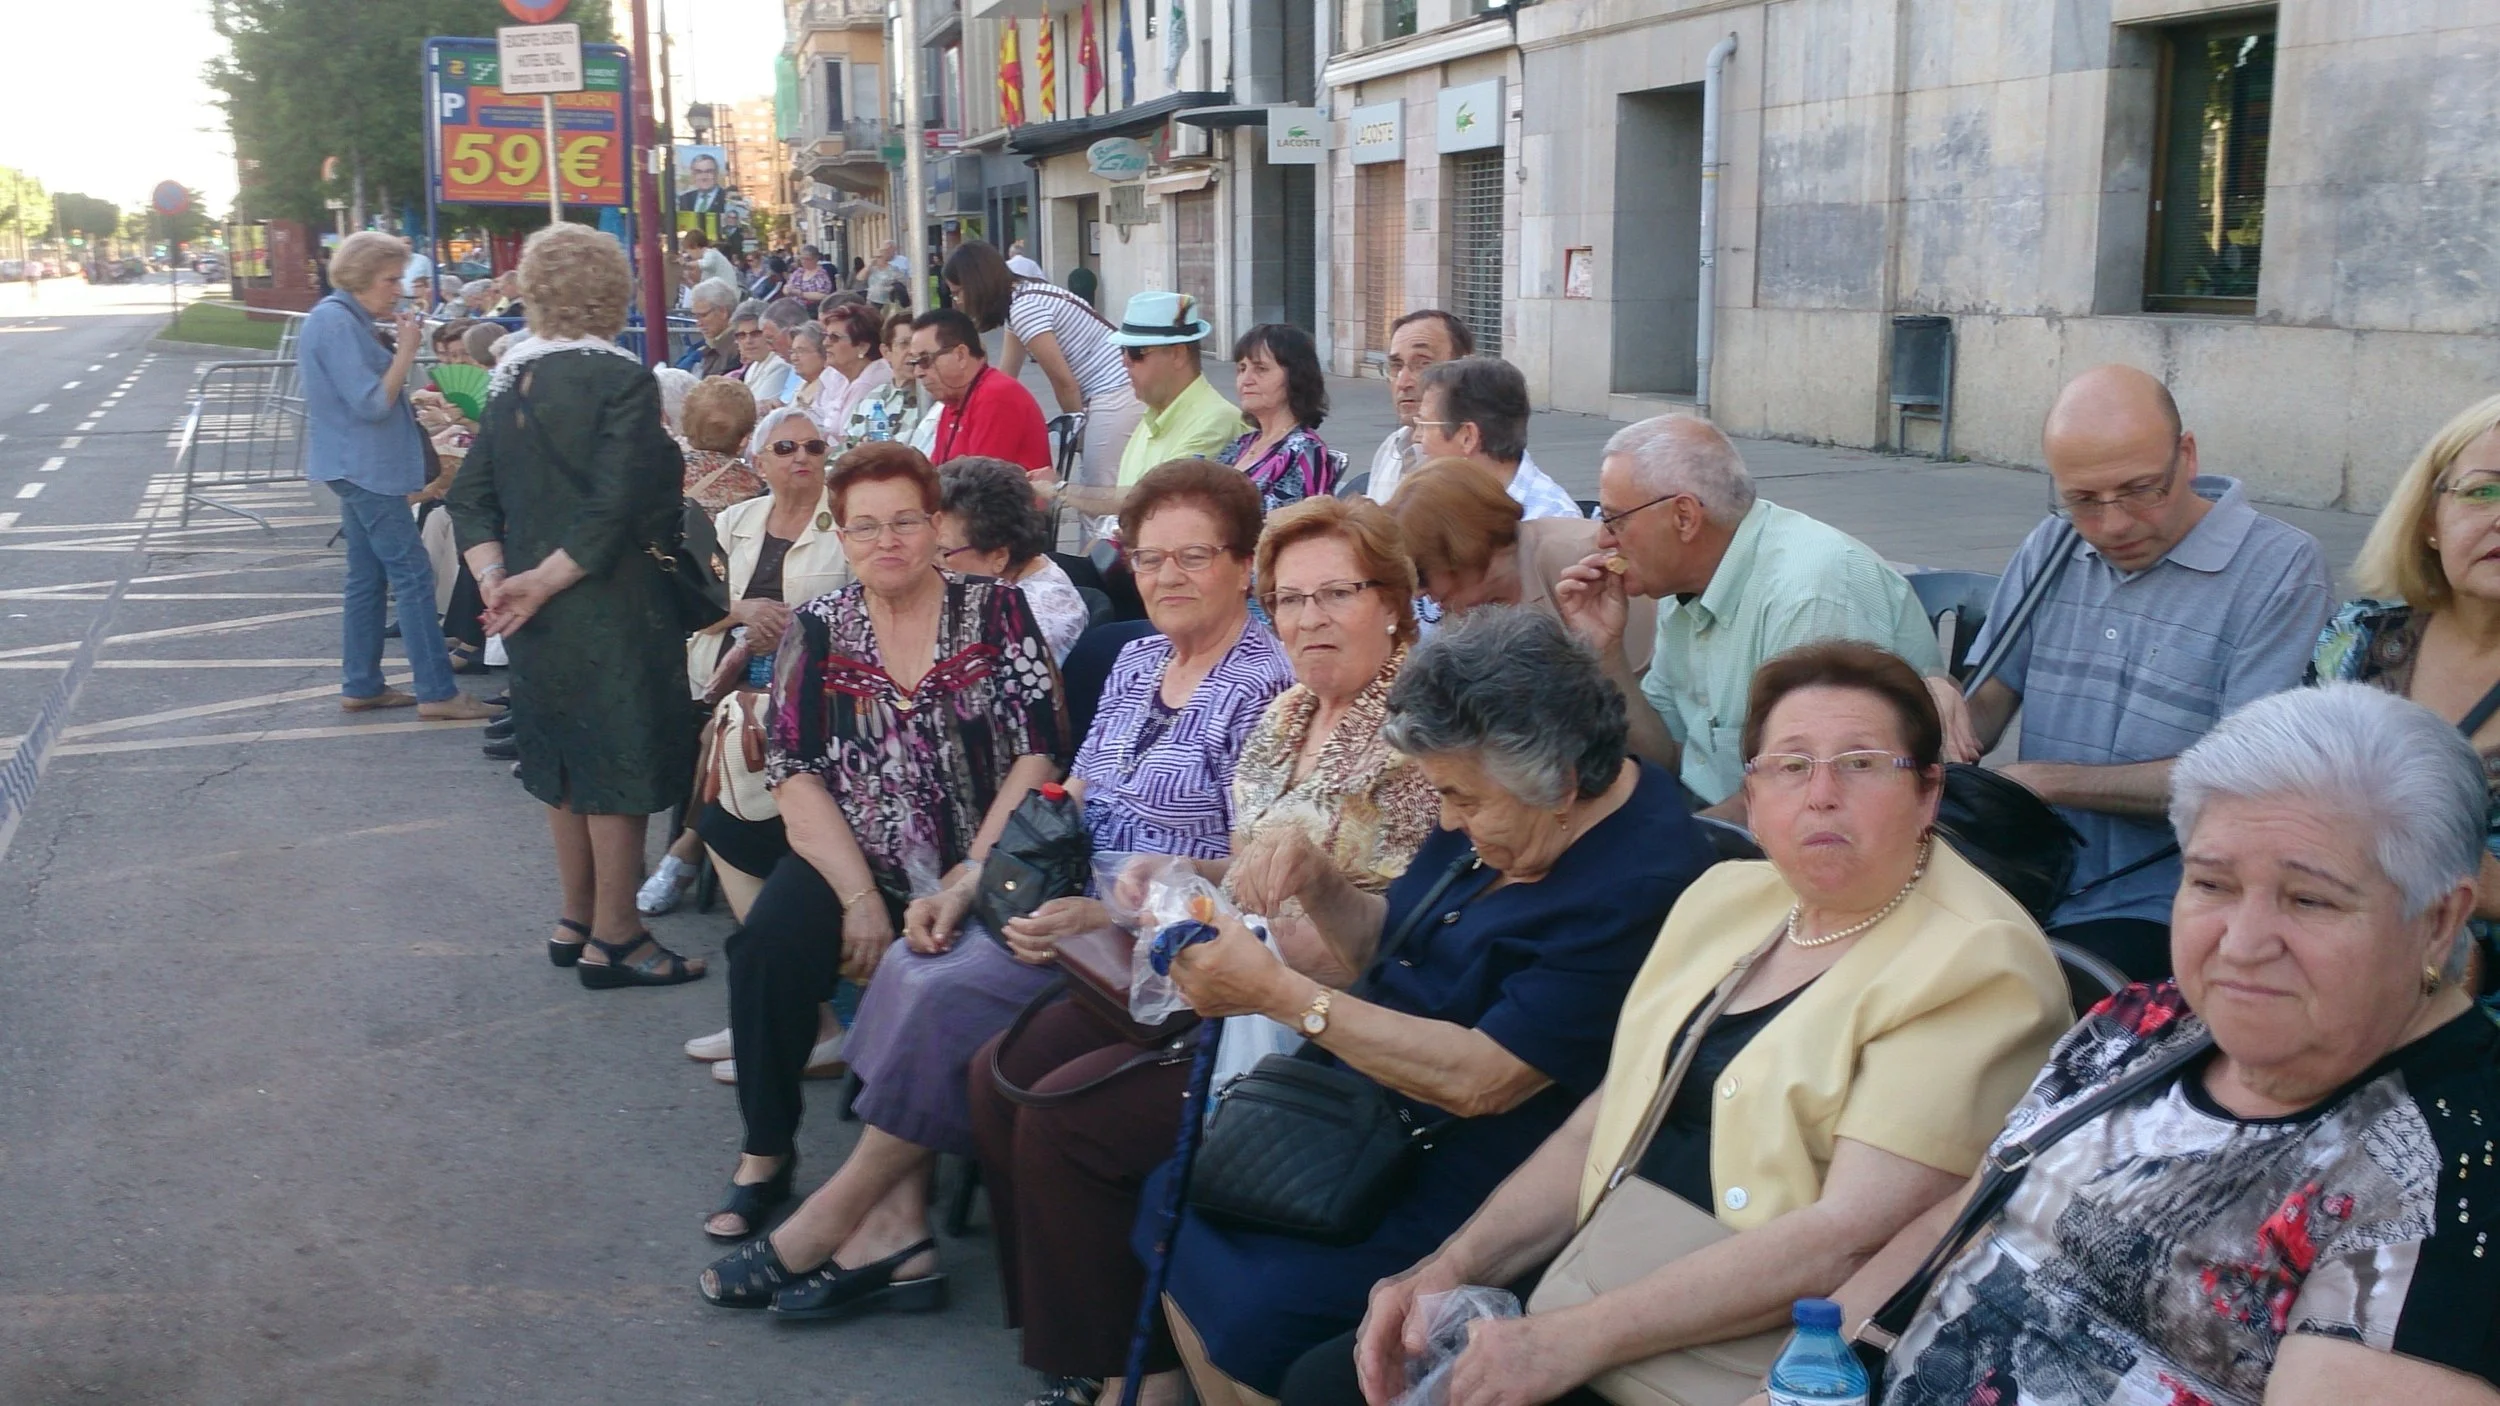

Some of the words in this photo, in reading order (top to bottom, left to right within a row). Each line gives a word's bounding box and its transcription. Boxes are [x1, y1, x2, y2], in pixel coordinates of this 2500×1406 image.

[442, 92, 466, 118] P
[1276, 138, 1321, 148] LACOSTE
[1356, 121, 1394, 145] LACOSTE
